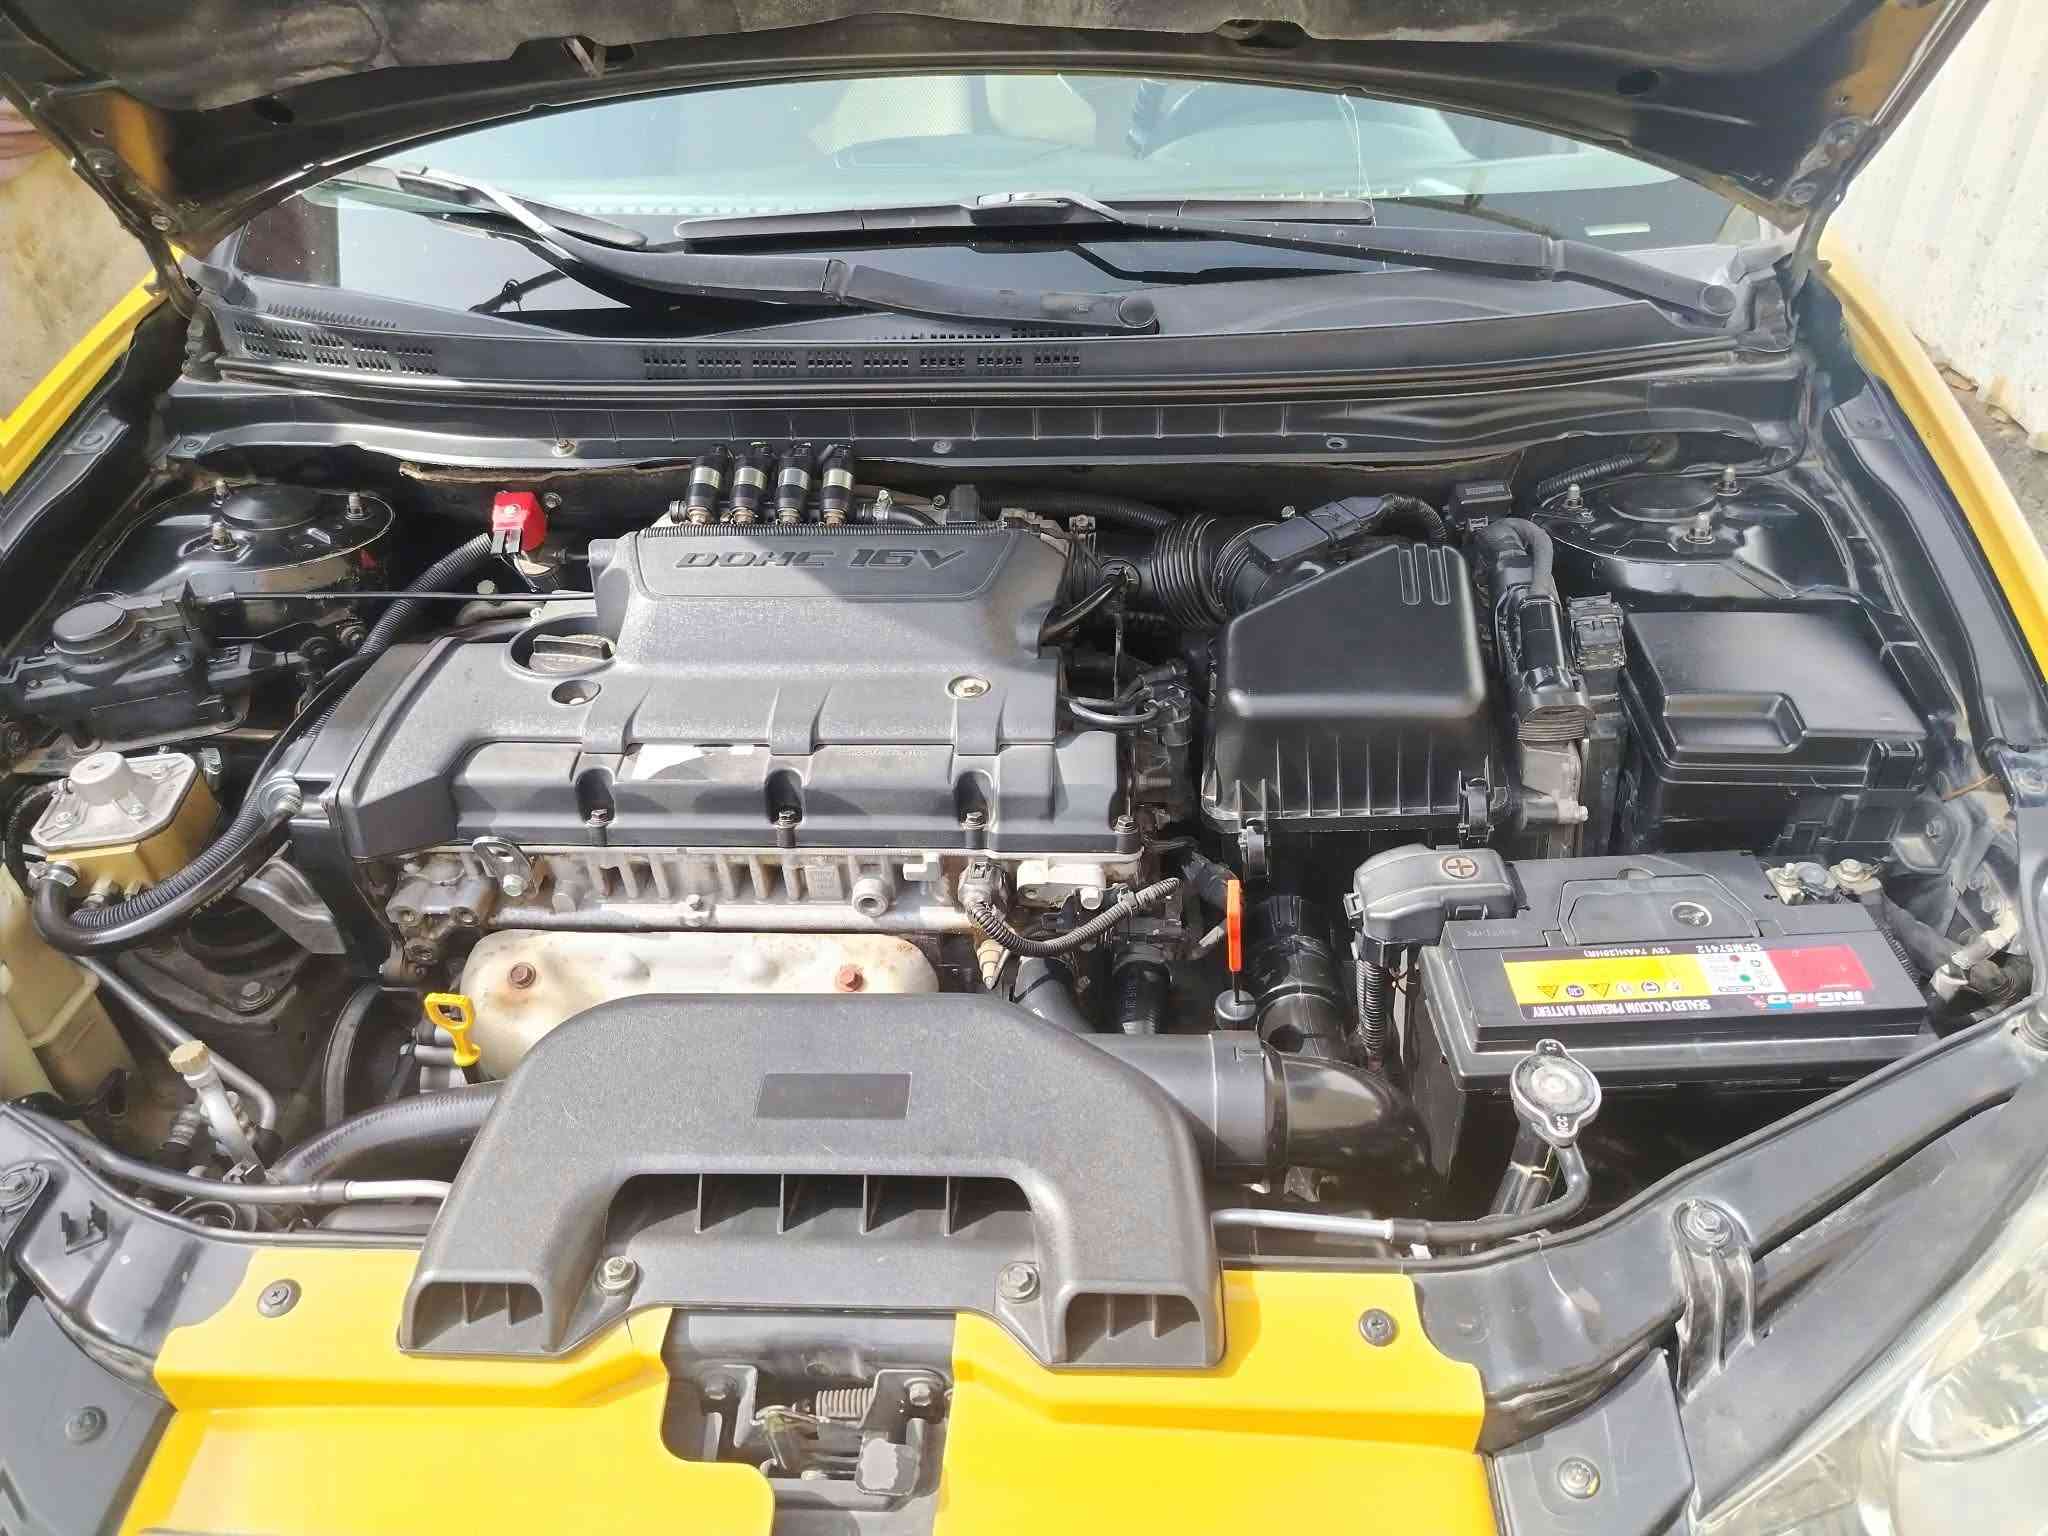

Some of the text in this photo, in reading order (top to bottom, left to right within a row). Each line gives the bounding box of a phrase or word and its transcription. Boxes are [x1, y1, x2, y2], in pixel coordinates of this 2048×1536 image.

[675, 549, 967, 569] DOHC 16V
[1766, 991, 1864, 1003] INDIGO
[1533, 999, 1712, 1018] SEALED CALCIUM PREMIUM BATTERY
